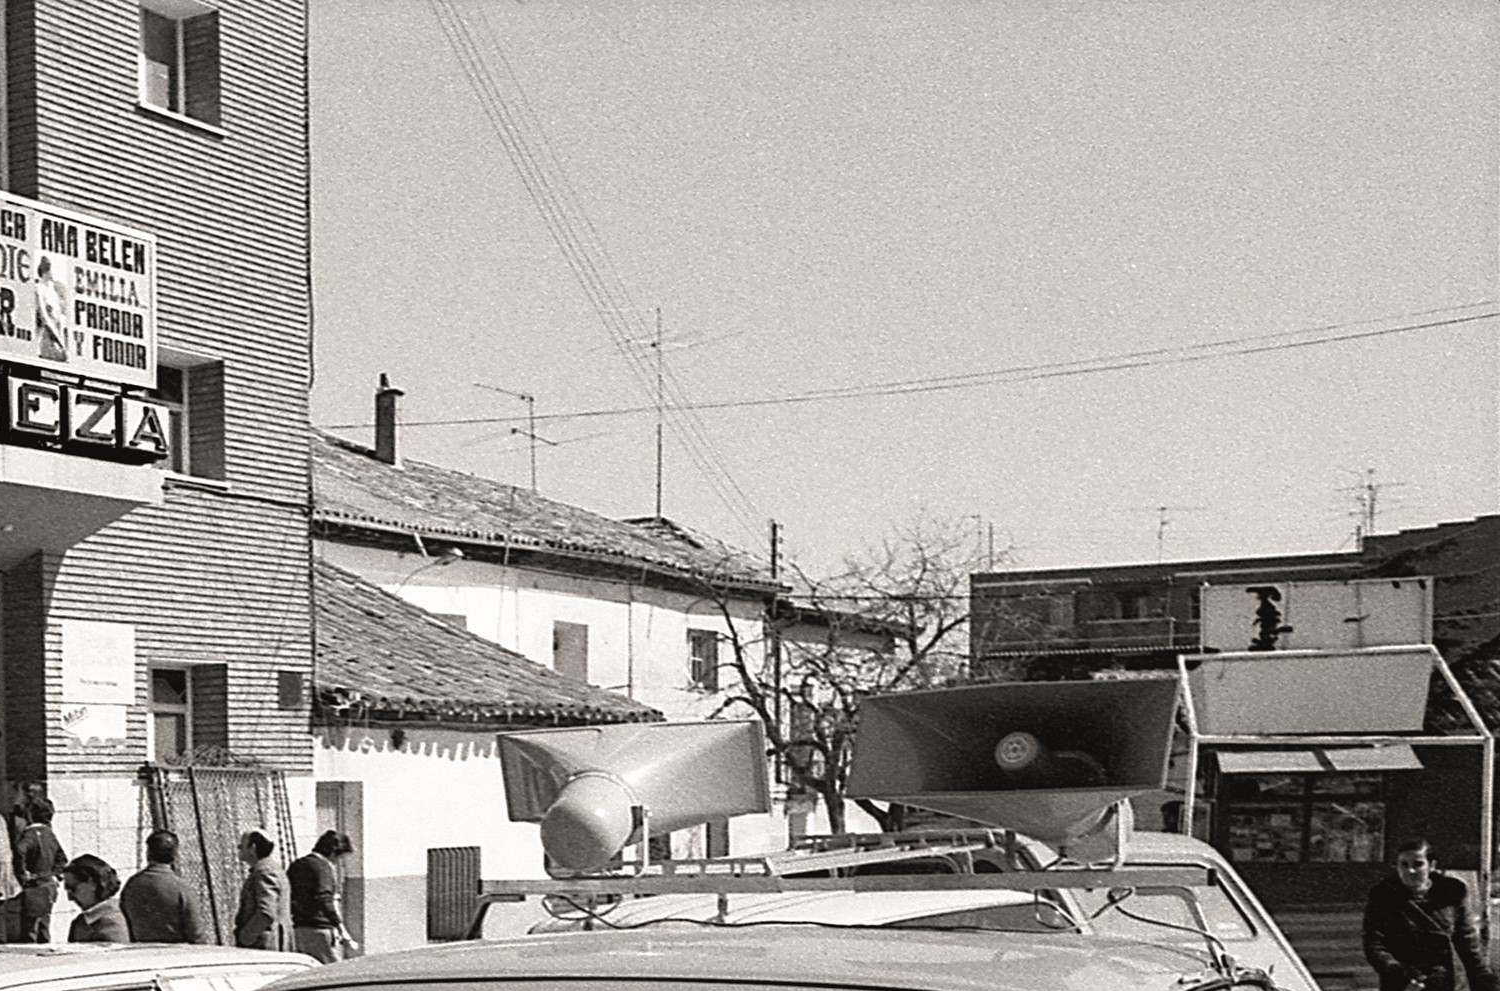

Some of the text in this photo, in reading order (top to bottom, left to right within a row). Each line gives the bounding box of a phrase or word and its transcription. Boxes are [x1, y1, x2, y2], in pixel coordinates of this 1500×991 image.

[40, 218, 146, 275] ANA BELEN
[74, 299, 144, 339] PARADA
[73, 330, 147, 370] Y FONDA
